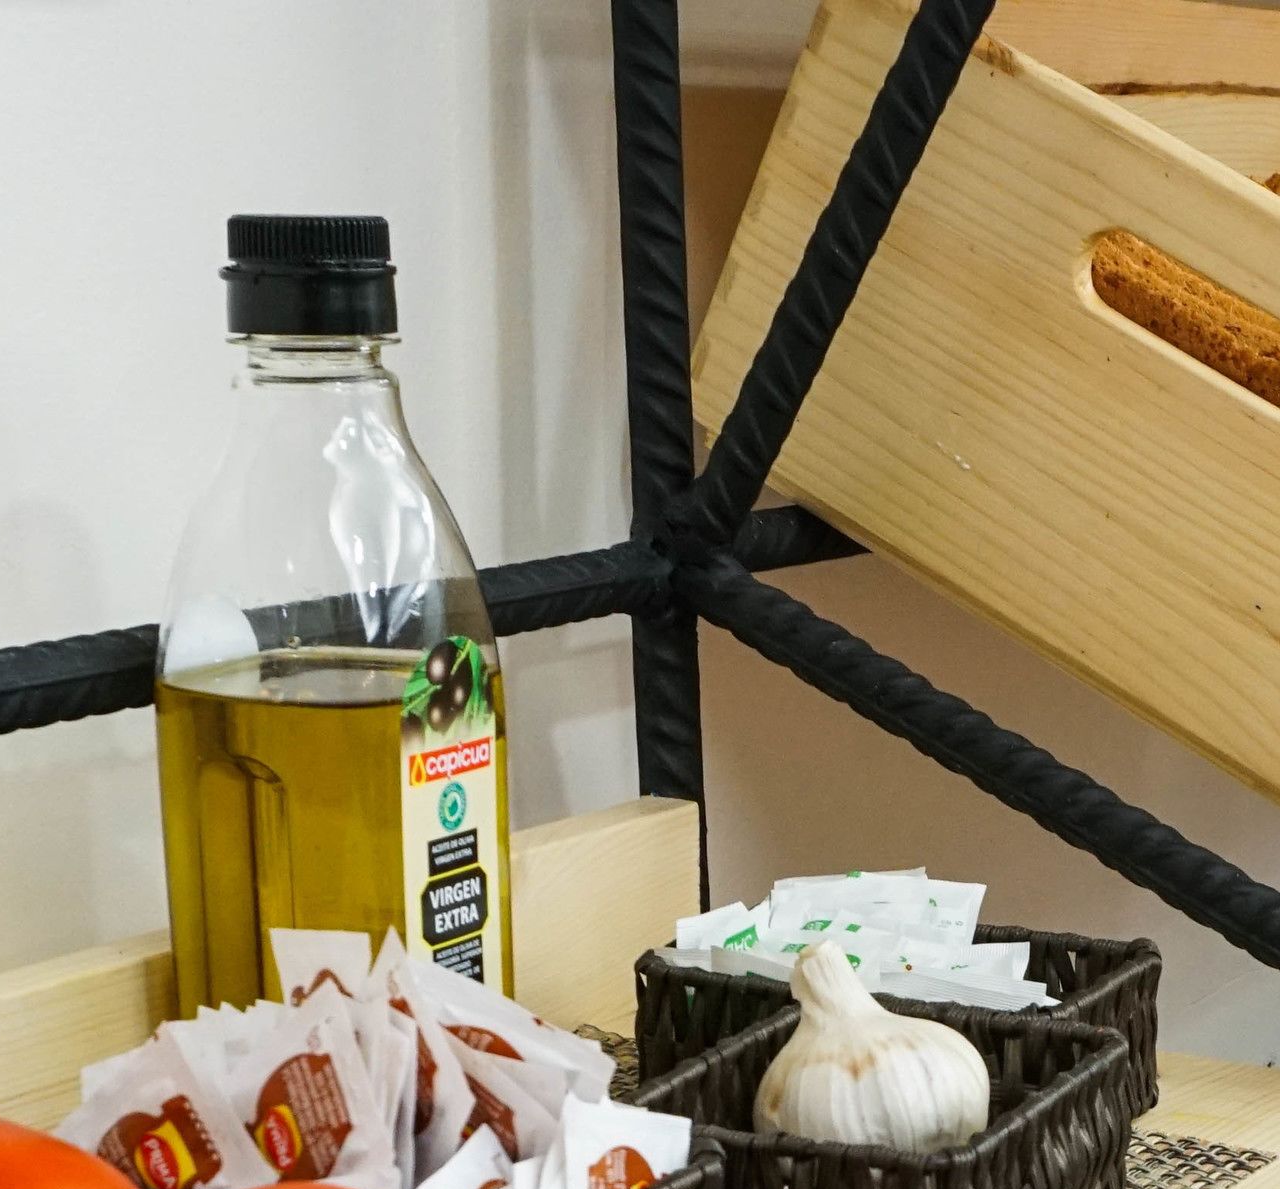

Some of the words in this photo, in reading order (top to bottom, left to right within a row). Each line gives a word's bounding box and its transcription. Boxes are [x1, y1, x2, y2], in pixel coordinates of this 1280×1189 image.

[426, 743, 490, 779] capicua
[429, 877, 481, 909] VIRGEN
[434, 903, 479, 933] EXTRA
